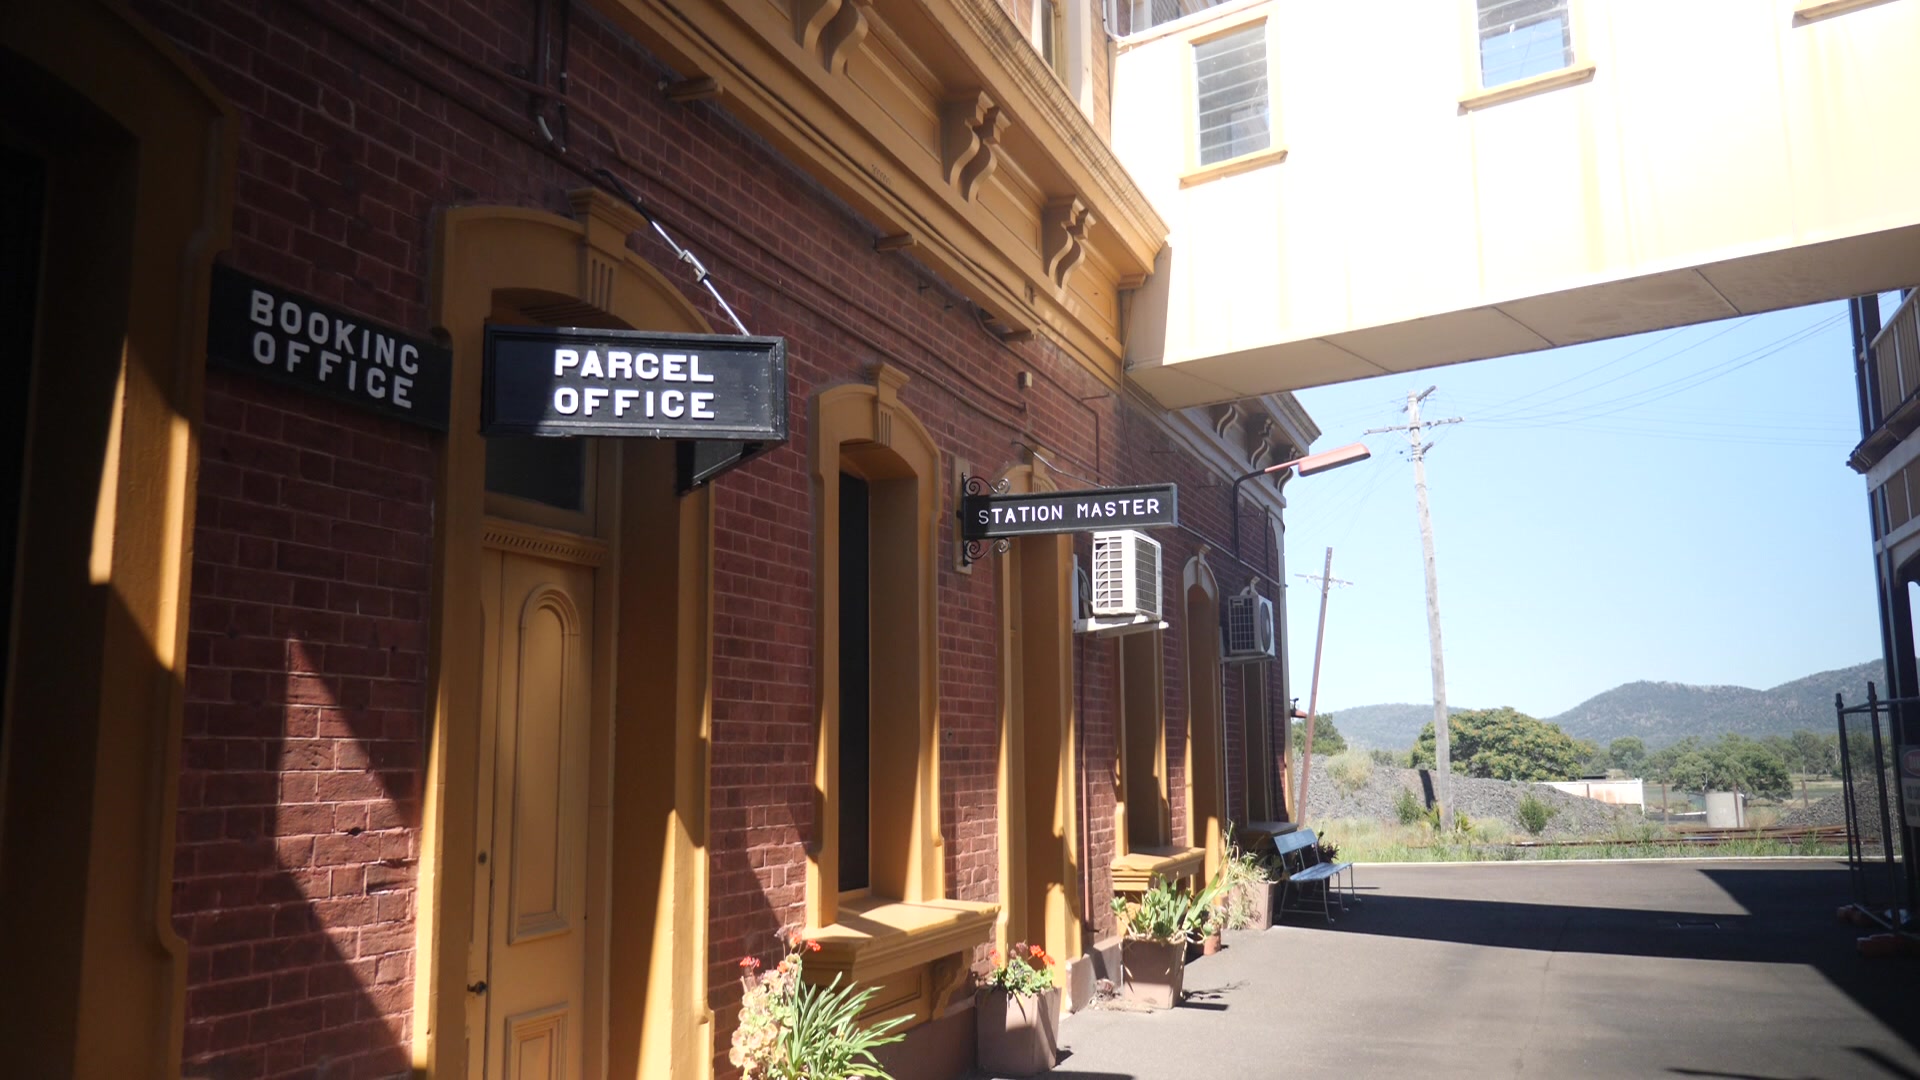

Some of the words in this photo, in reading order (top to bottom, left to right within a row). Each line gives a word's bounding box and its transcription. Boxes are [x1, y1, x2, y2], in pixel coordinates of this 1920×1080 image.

[253, 332, 413, 408] OFFICE
[554, 349, 714, 382] PARCEL
[554, 387, 715, 419] OFFICE
[978, 504, 1063, 525] STATION
[1076, 497, 1160, 519] MASTER
